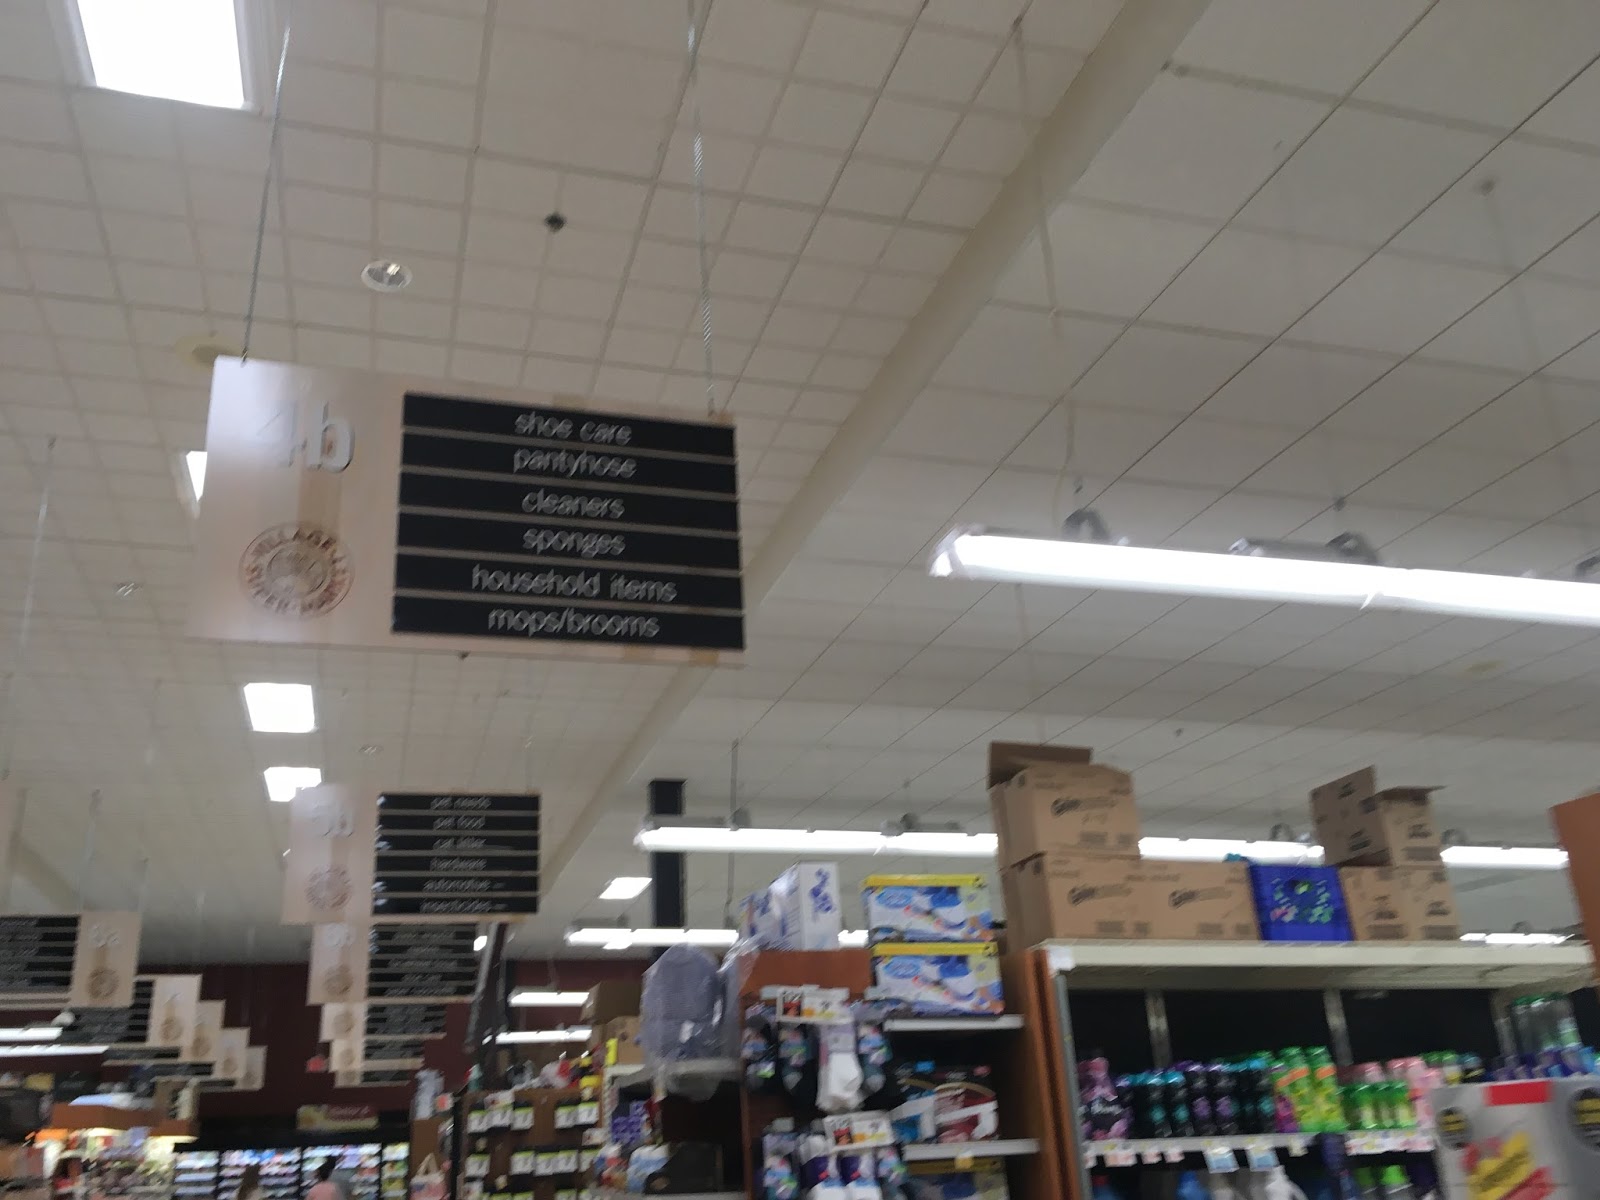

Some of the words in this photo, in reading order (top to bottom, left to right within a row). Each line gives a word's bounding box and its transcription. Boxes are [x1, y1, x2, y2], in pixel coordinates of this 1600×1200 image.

[515, 411, 573, 439] shoe
[580, 421, 632, 446] care
[513, 448, 637, 479] pantyhose
[522, 488, 625, 519] cleaners
[523, 528, 626, 558] sponges
[472, 563, 600, 598] household
[610, 573, 678, 603] items
[488, 607, 660, 638] mops/brooms
